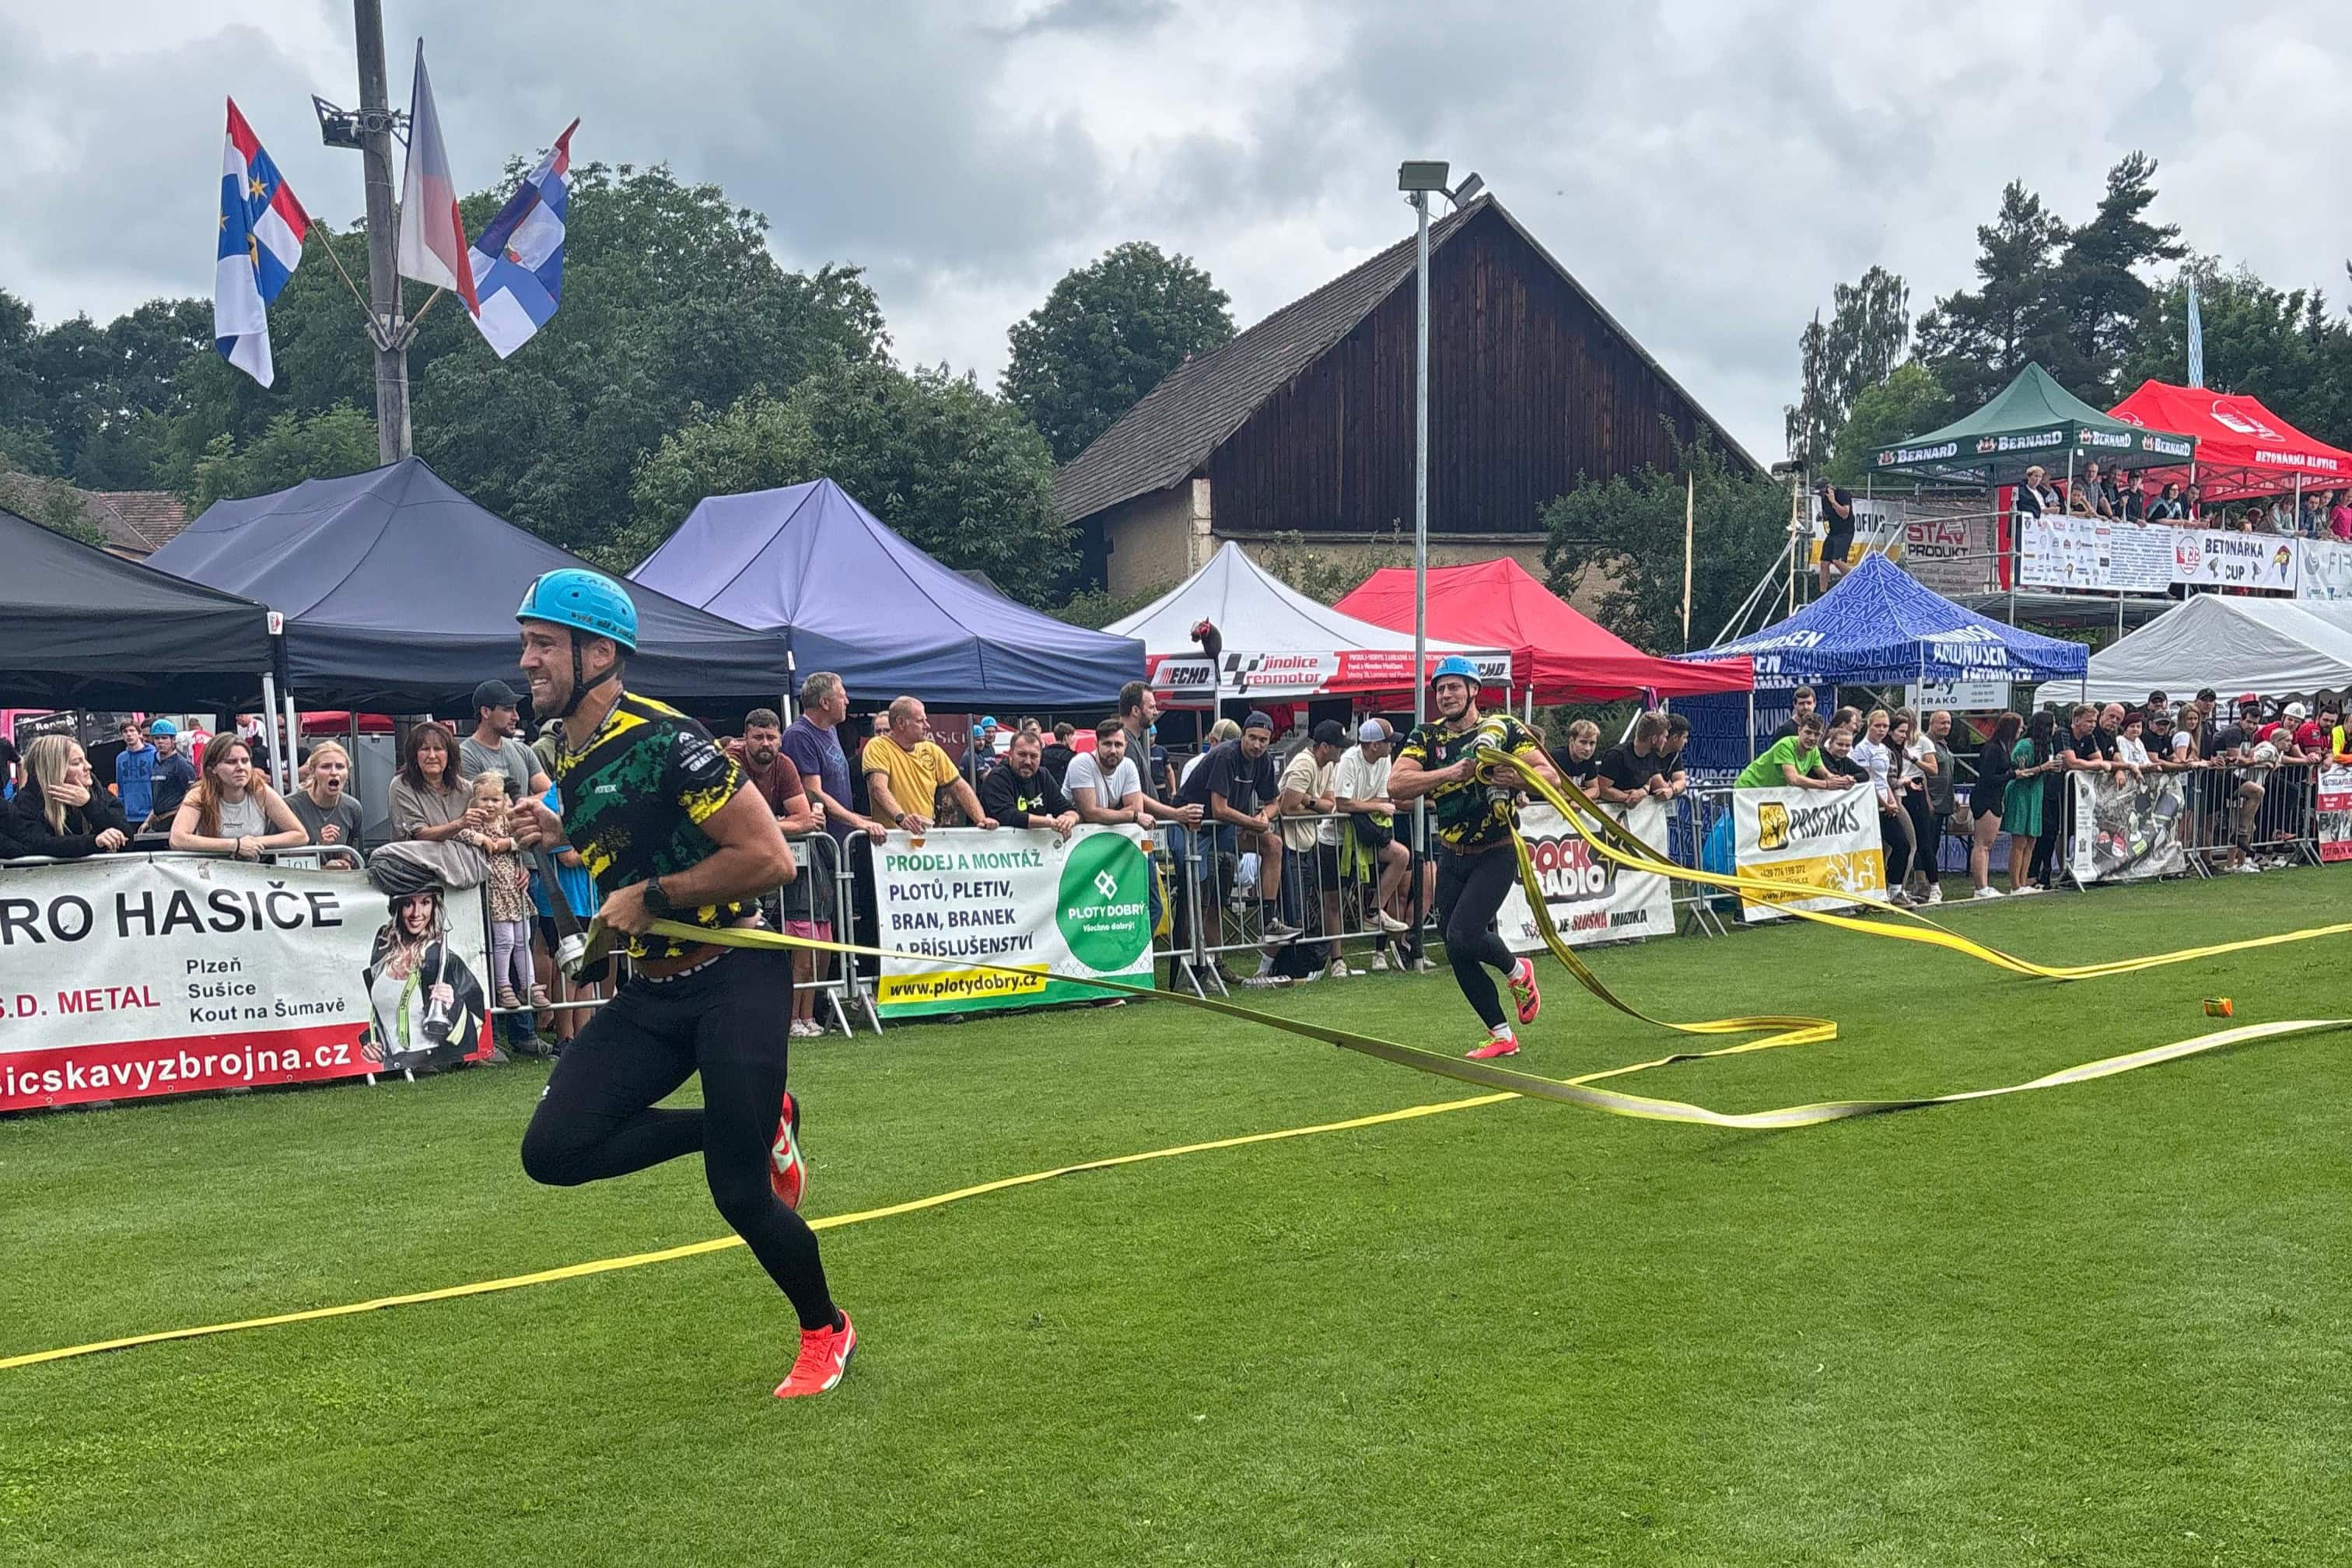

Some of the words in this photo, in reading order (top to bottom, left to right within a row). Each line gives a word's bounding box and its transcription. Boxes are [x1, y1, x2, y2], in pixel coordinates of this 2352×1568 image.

[1997, 430, 2063, 451] BERNARD
[2092, 432, 2132, 448] BERNARD
[2154, 436, 2191, 457] BERNARD
[1896, 442, 1958, 464] BERNARD
[1908, 543, 1969, 558] PRODUKT
[2205, 536, 2265, 559] BETONÁRKA
[2225, 565, 2245, 580] CUP
[1260, 655, 1318, 672] jinolice
[1933, 642, 2007, 667] AMUNDSEN
[1170, 667, 1210, 684] ECHO
[1479, 663, 1506, 677] CHO
[886, 854, 954, 872] PRODEJ
[957, 854, 969, 870] A
[971, 849, 1044, 870] MONTÁŽ
[889, 878, 948, 902] PLOTŮ,
[953, 880, 1014, 901] PLETIV,
[115, 880, 344, 938] HASIČE
[892, 912, 944, 931] BRAN,
[947, 908, 1017, 927] BRANEK
[1571, 909, 1608, 932] SLUŠNÁ
[1610, 908, 1648, 928] MUZIKA
[909, 930, 1034, 957] PŘÍSLUŠENSTVÍ
[187, 957, 242, 975] Plzeň
[187, 982, 257, 999] Sušice
[890, 973, 1038, 998] www.plotydobry.cz
[58, 985, 161, 1014] METAL
[190, 1006, 237, 1023] Kout
[244, 1006, 268, 1020] na
[275, 997, 345, 1017] Šumavě
[0, 1044, 351, 1097] icskavyzbrojna.cz
